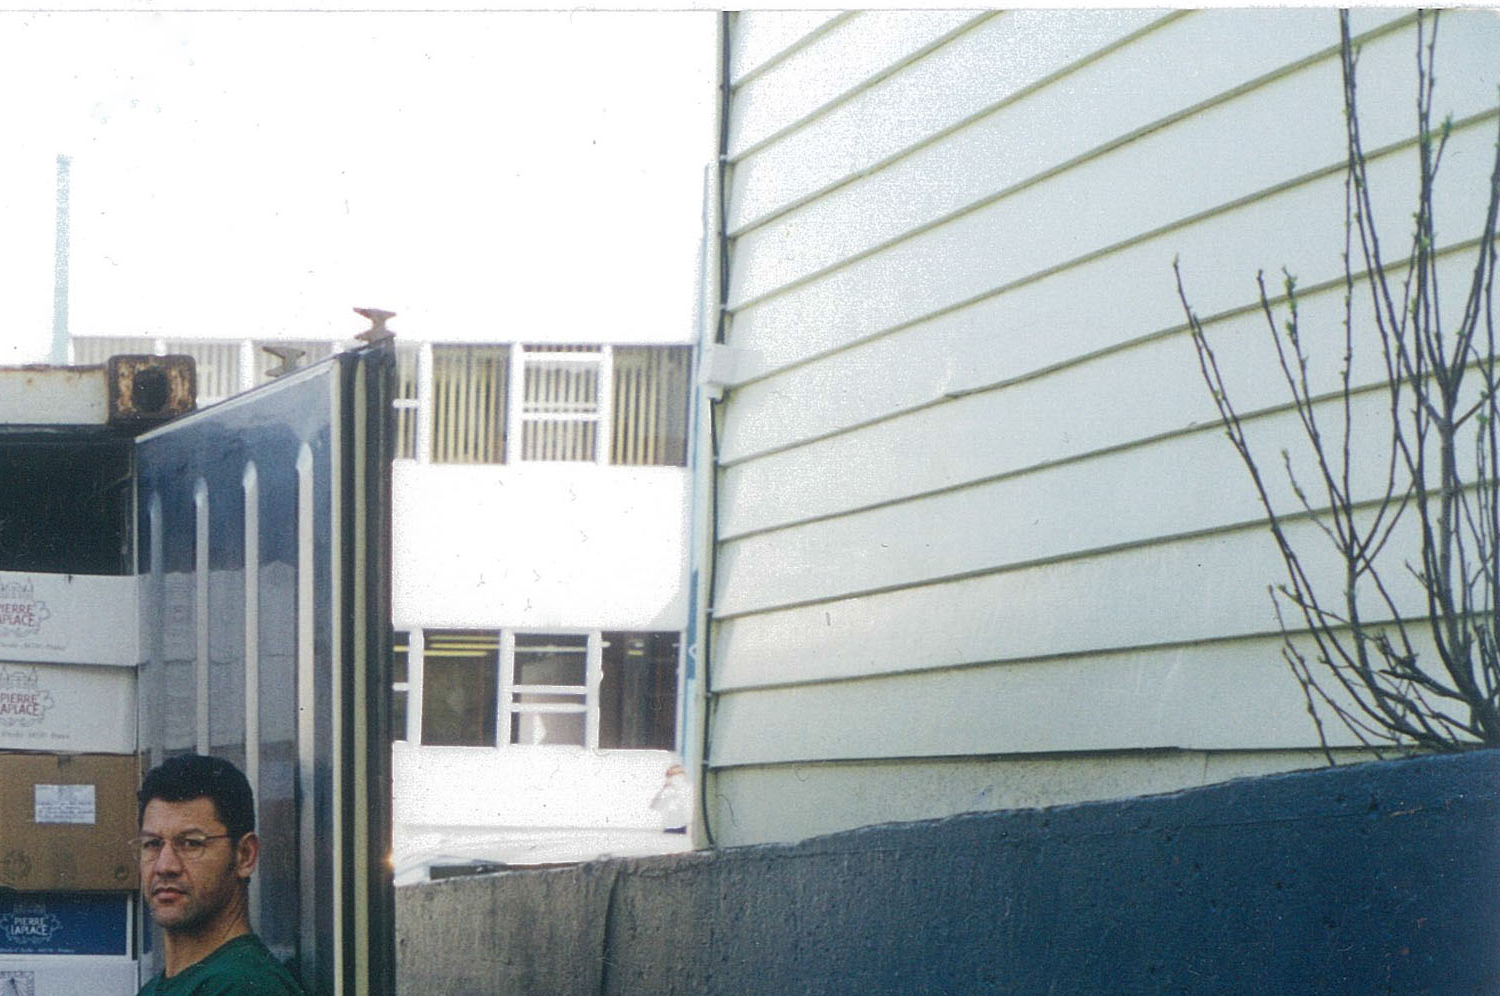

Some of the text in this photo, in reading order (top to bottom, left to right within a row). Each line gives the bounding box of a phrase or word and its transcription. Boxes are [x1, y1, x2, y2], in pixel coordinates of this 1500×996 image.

[0, 692, 38, 705] PIERRE
[13, 916, 45, 926] PIERRE
[10, 925, 49, 936] LAPLACE
